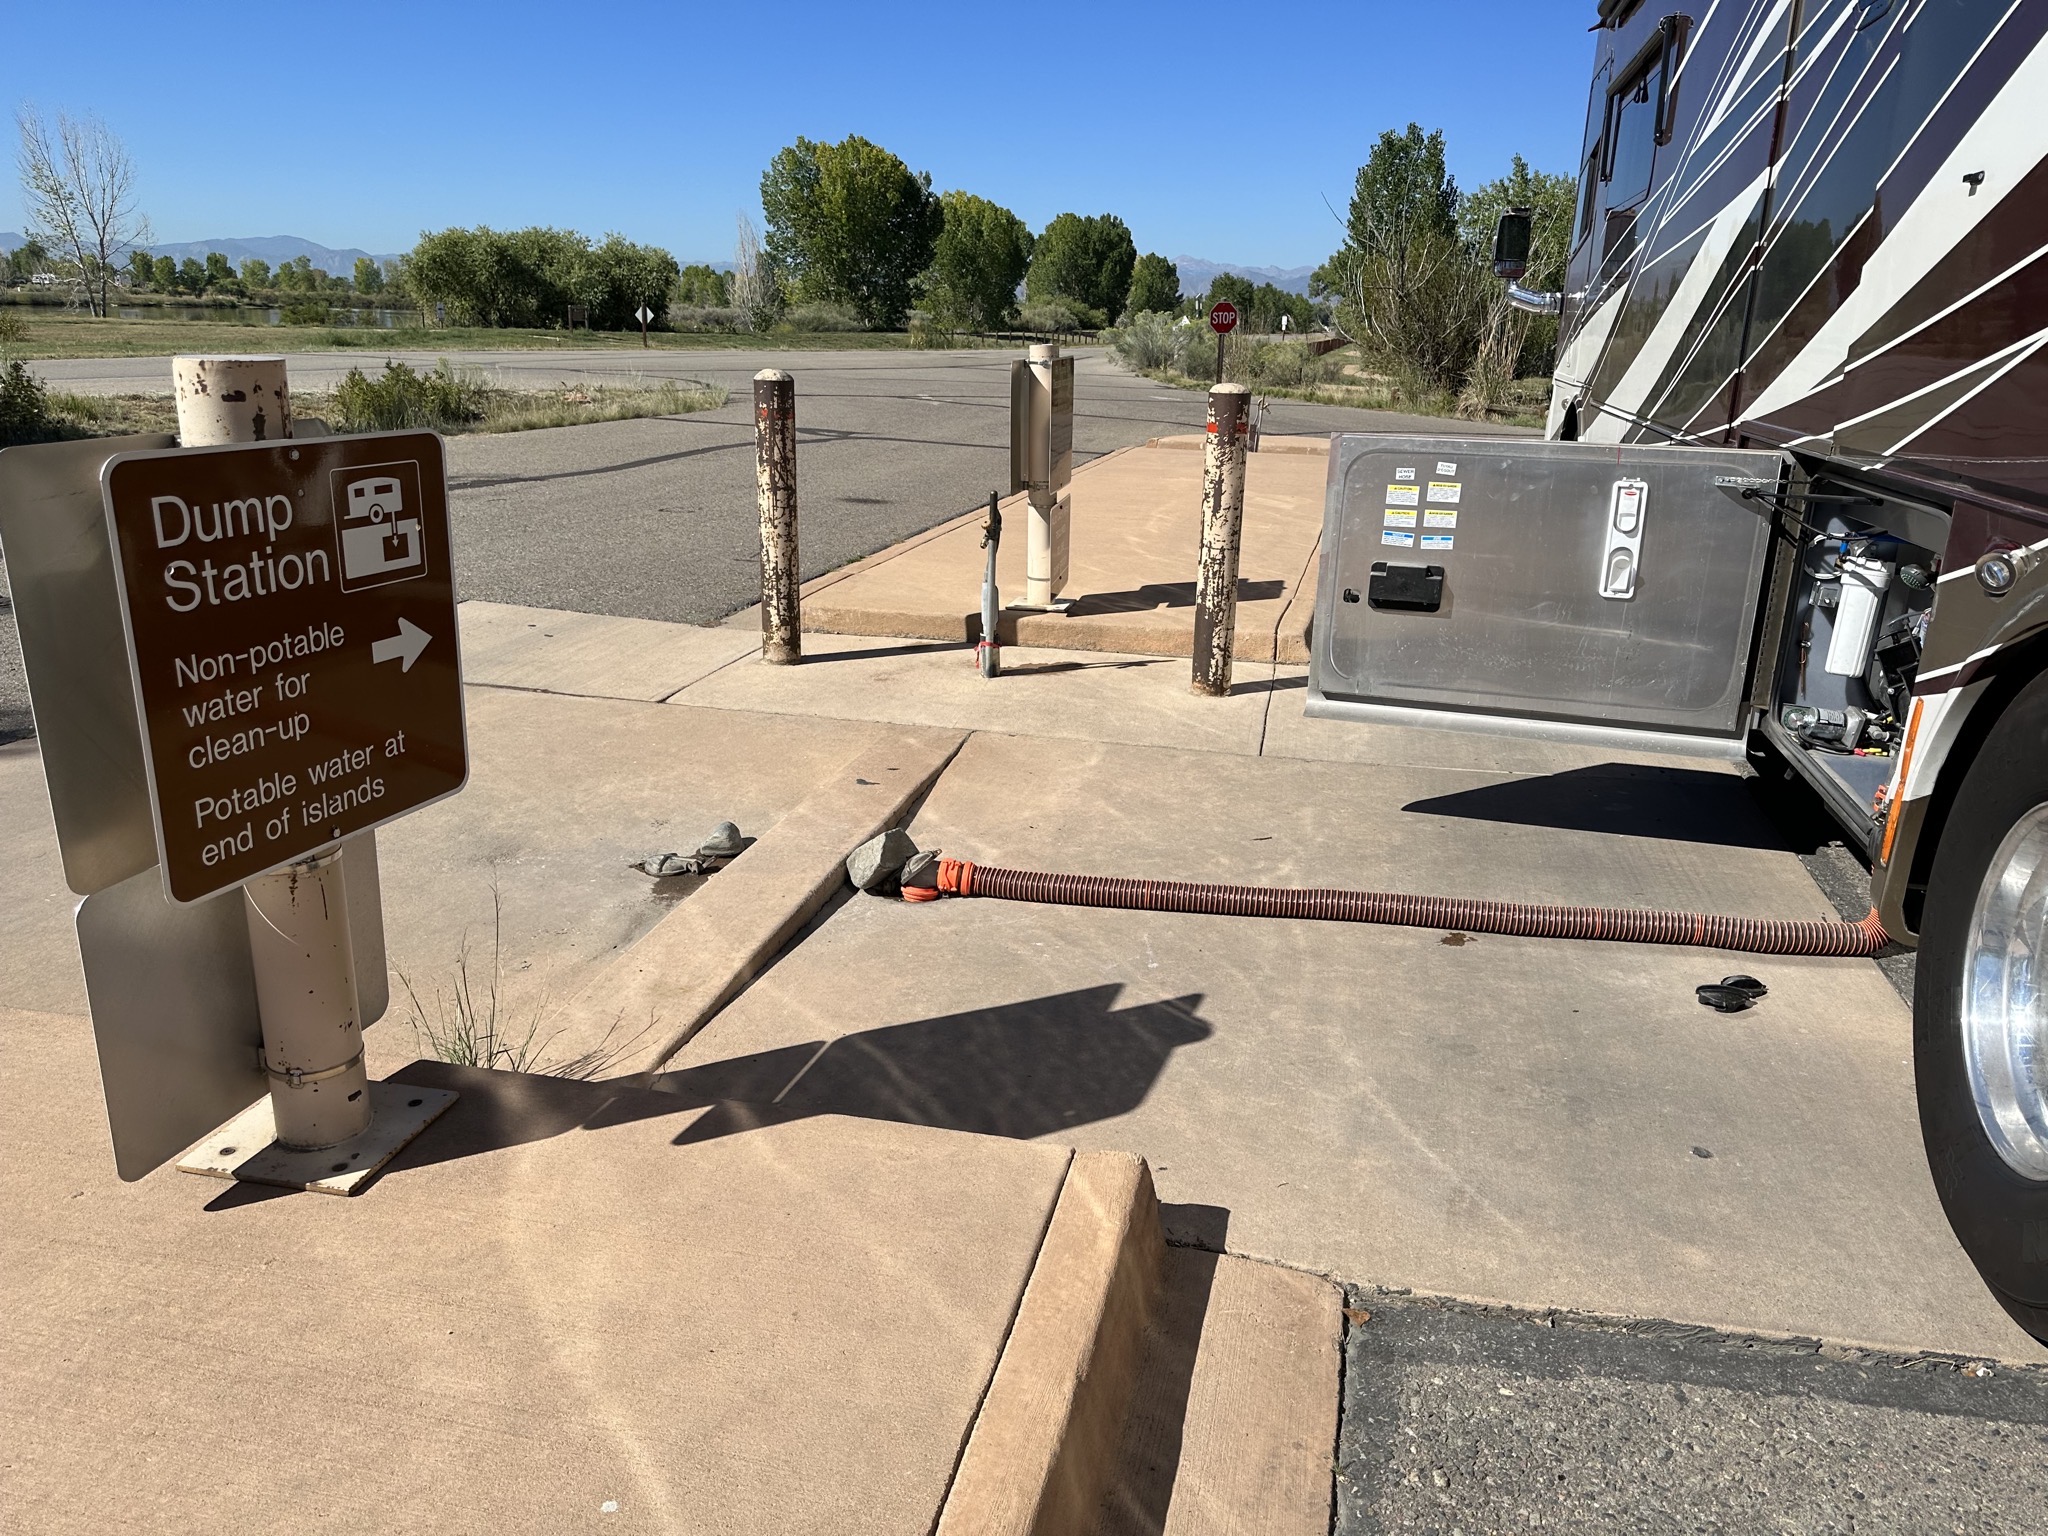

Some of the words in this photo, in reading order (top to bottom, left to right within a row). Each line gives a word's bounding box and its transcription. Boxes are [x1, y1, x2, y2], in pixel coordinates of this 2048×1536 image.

[1212, 312, 1235, 324] STOP
[151, 494, 293, 549] Dump
[164, 545, 330, 612] Station
[175, 622, 344, 688] Non-potable
[182, 686, 263, 728] water
[275, 672, 311, 701] for
[188, 713, 310, 769] clean-up
[195, 772, 297, 829] Potable
[307, 744, 374, 785] water
[385, 730, 406, 758] at
[202, 822, 254, 866] end
[266, 806, 291, 840] of
[302, 777, 385, 827] islands
